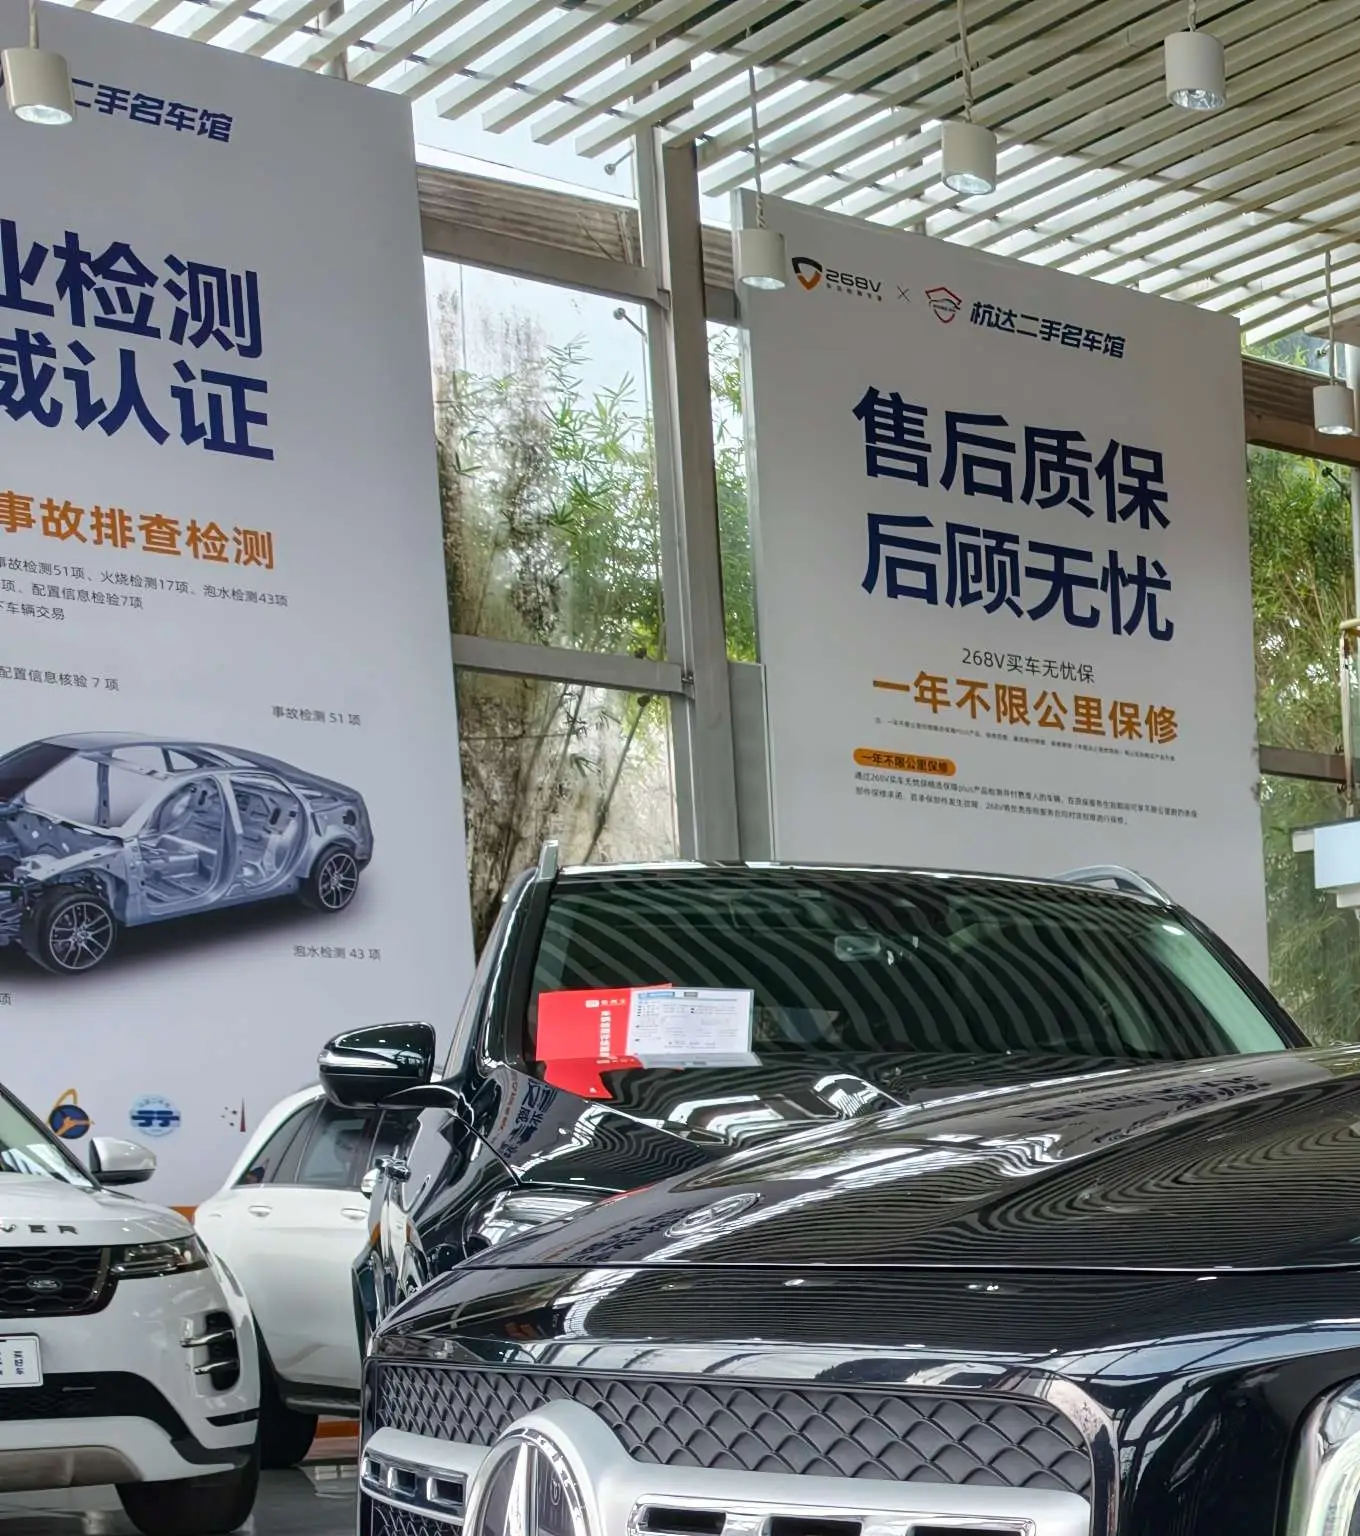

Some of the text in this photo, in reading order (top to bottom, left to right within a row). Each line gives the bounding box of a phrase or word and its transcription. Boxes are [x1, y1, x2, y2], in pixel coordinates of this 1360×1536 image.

[825, 269, 881, 293] 268V
[970, 301, 1126, 358] 杭达二手名车馆
[852, 386, 1171, 530] 售后质保
[861, 512, 1174, 642] 后顾无忧
[93, 676, 101, 689] 7
[105, 678, 120, 692] 项
[962, 647, 1096, 685] 268V买车无忧保
[328, 712, 345, 725] 51
[872, 671, 1179, 745] 一年不限公里保修
